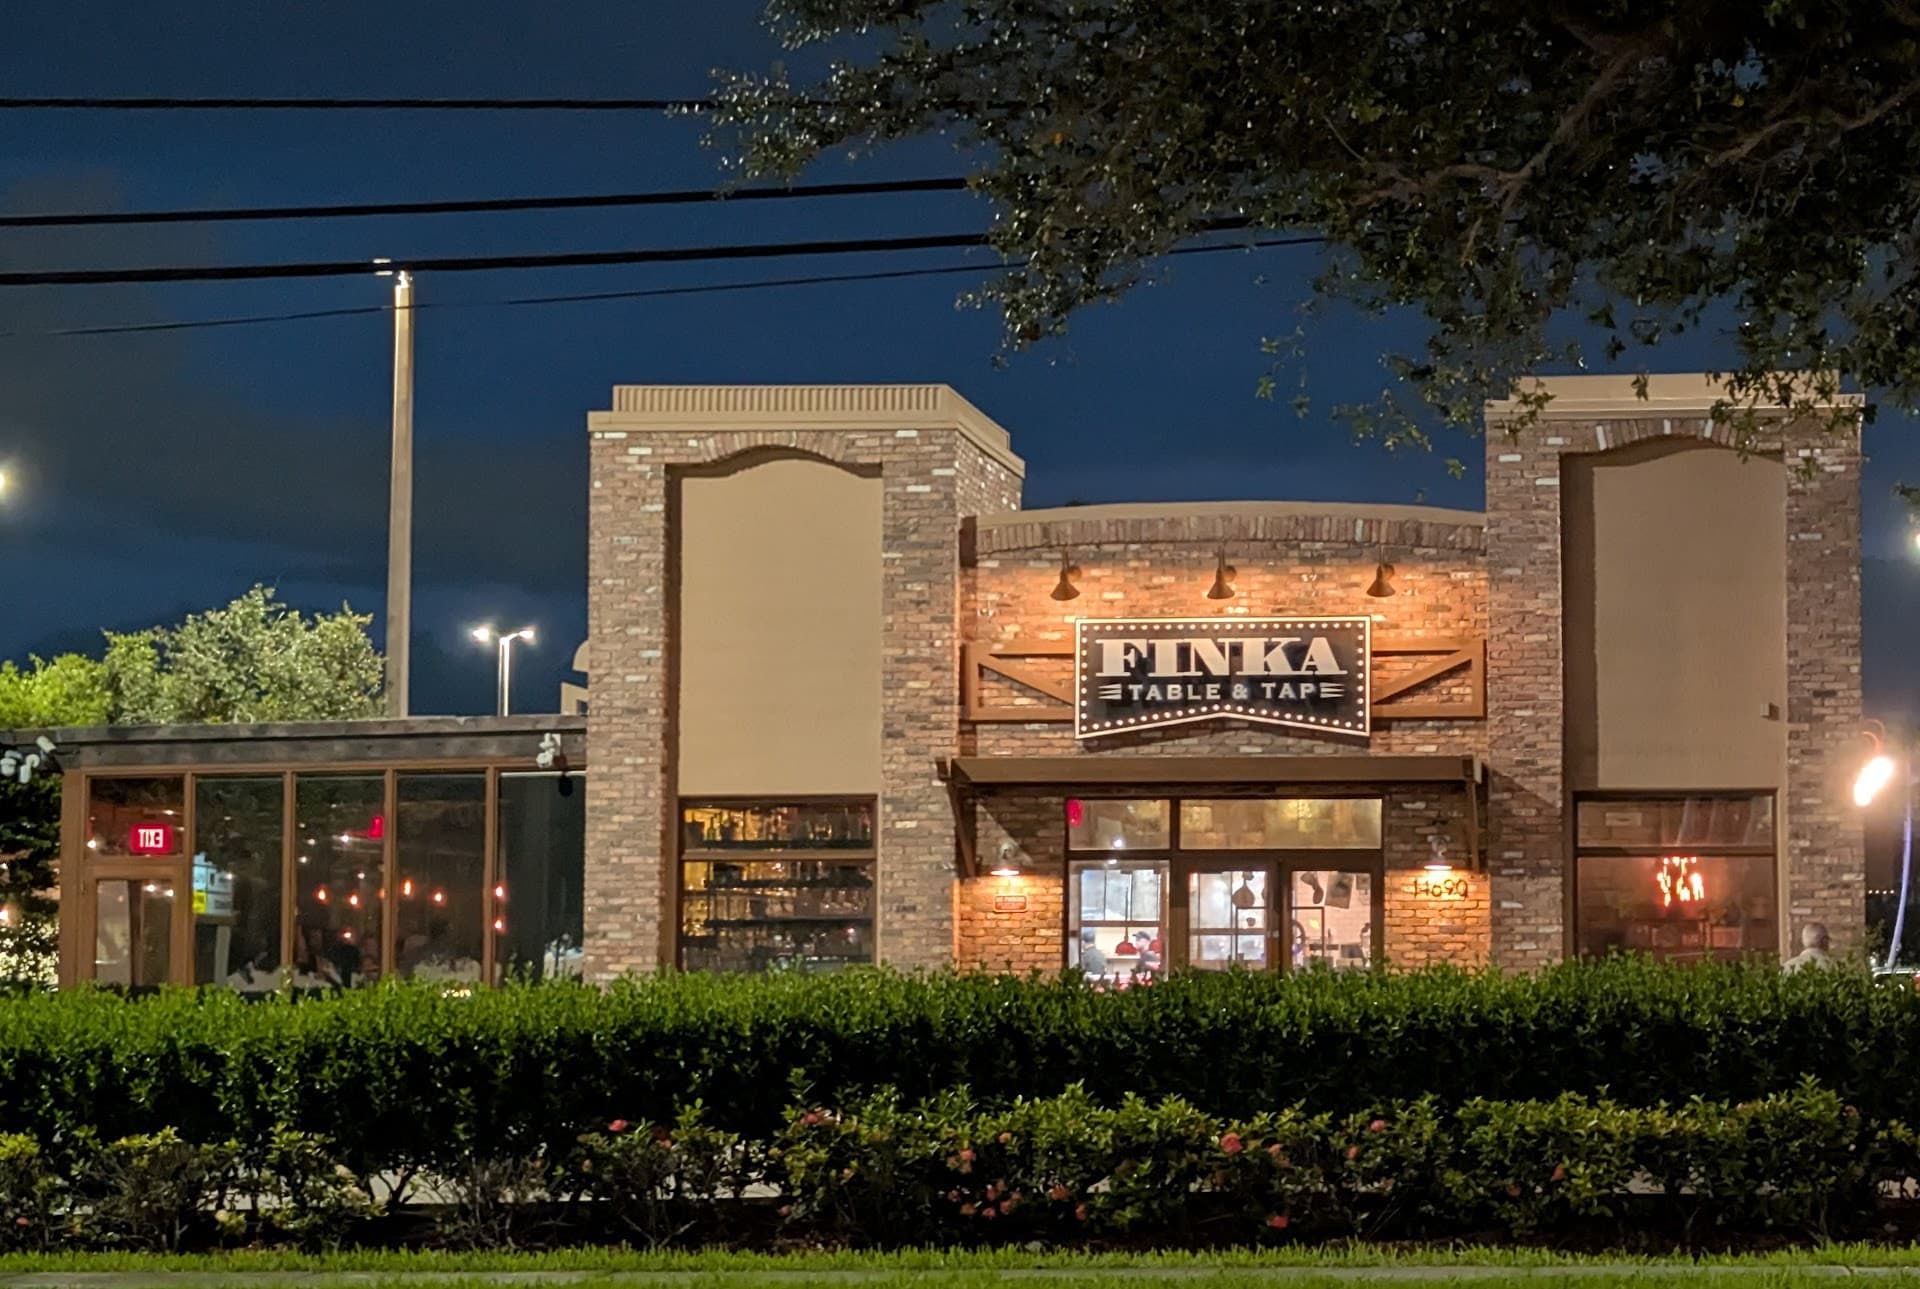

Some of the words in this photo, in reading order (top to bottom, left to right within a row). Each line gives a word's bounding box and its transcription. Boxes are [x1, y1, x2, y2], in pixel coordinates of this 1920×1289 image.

[1096, 637, 1348, 677] FINKA
[1128, 684, 1221, 701] TABLE
[1232, 683, 1248, 699] &
[1261, 682, 1316, 699] TAP
